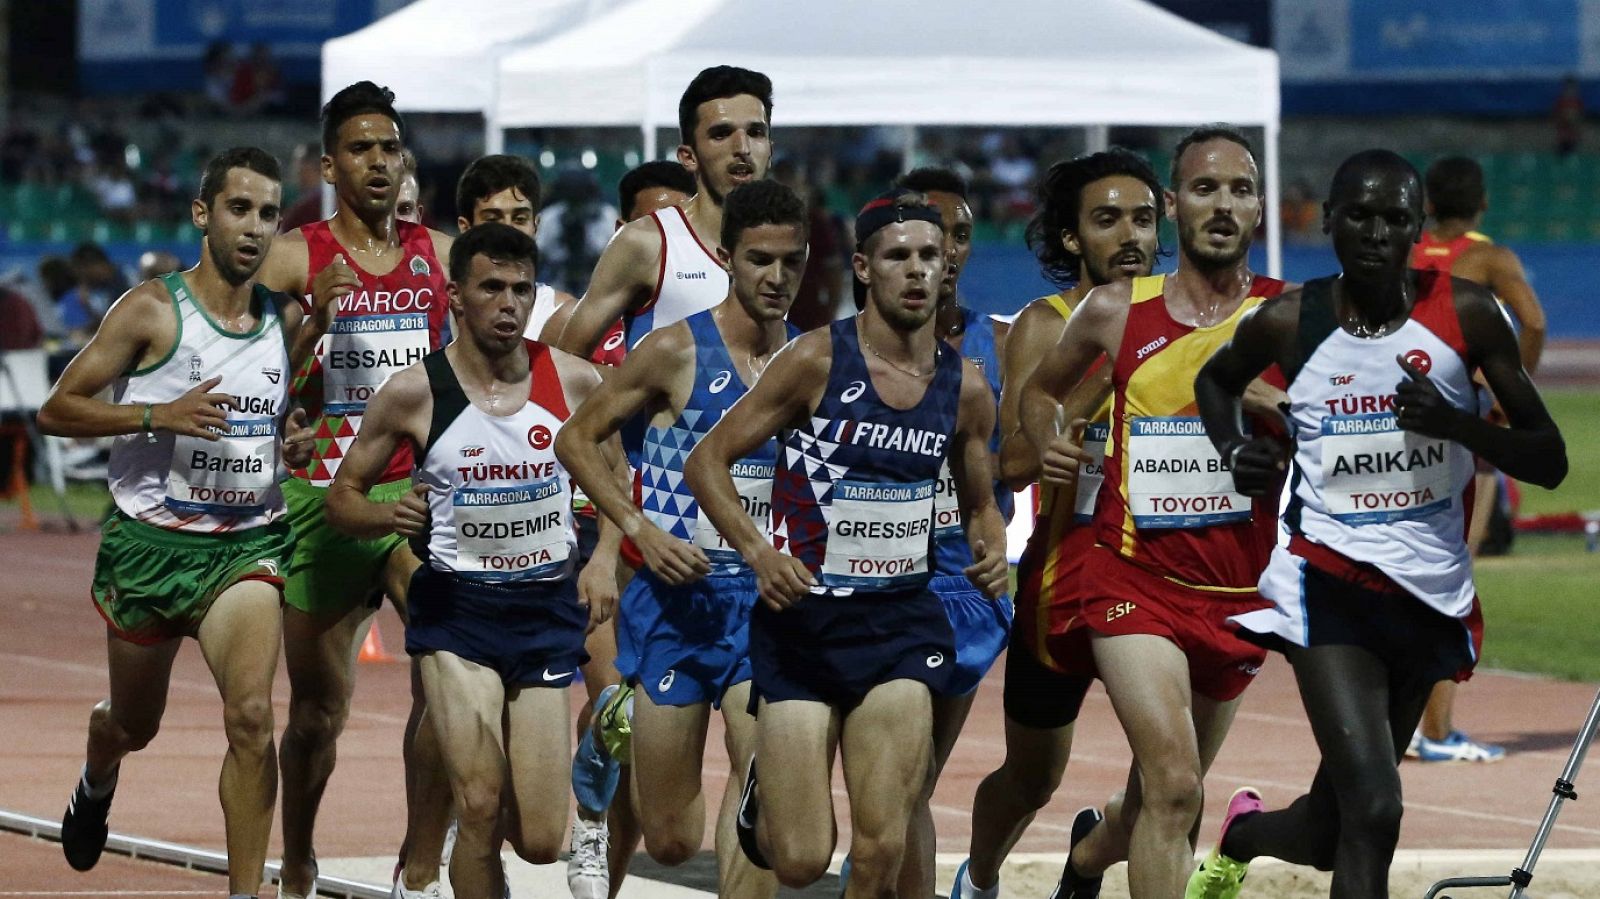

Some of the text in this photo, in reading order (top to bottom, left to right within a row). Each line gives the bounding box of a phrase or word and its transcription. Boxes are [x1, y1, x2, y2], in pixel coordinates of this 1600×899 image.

[337, 288, 433, 312] MAROC
[333, 317, 424, 333] TARRAGONA 2018
[1331, 374, 1356, 386] TAF
[252, 424, 272, 436] 2018
[852, 421, 948, 457] FRANCE
[462, 447, 485, 458] TAF
[1332, 443, 1444, 477] ARIKAN
[190, 450, 262, 473] Barata
[1133, 459, 1202, 473] ABADIA
[731, 464, 775, 478] RAGONA
[189, 487, 256, 504] TOYOTA
[463, 482, 559, 505] TARRAGONA 2018
[844, 484, 932, 500] TARRAGONA 2018
[1351, 487, 1435, 509] TOYOTA
[1150, 496, 1233, 513] TOYOTA
[461, 511, 562, 539] OZDEMIR
[836, 518, 930, 539] GRESSIER
[479, 548, 552, 570] TOYOTA
[848, 558, 915, 575] TOYOTA
